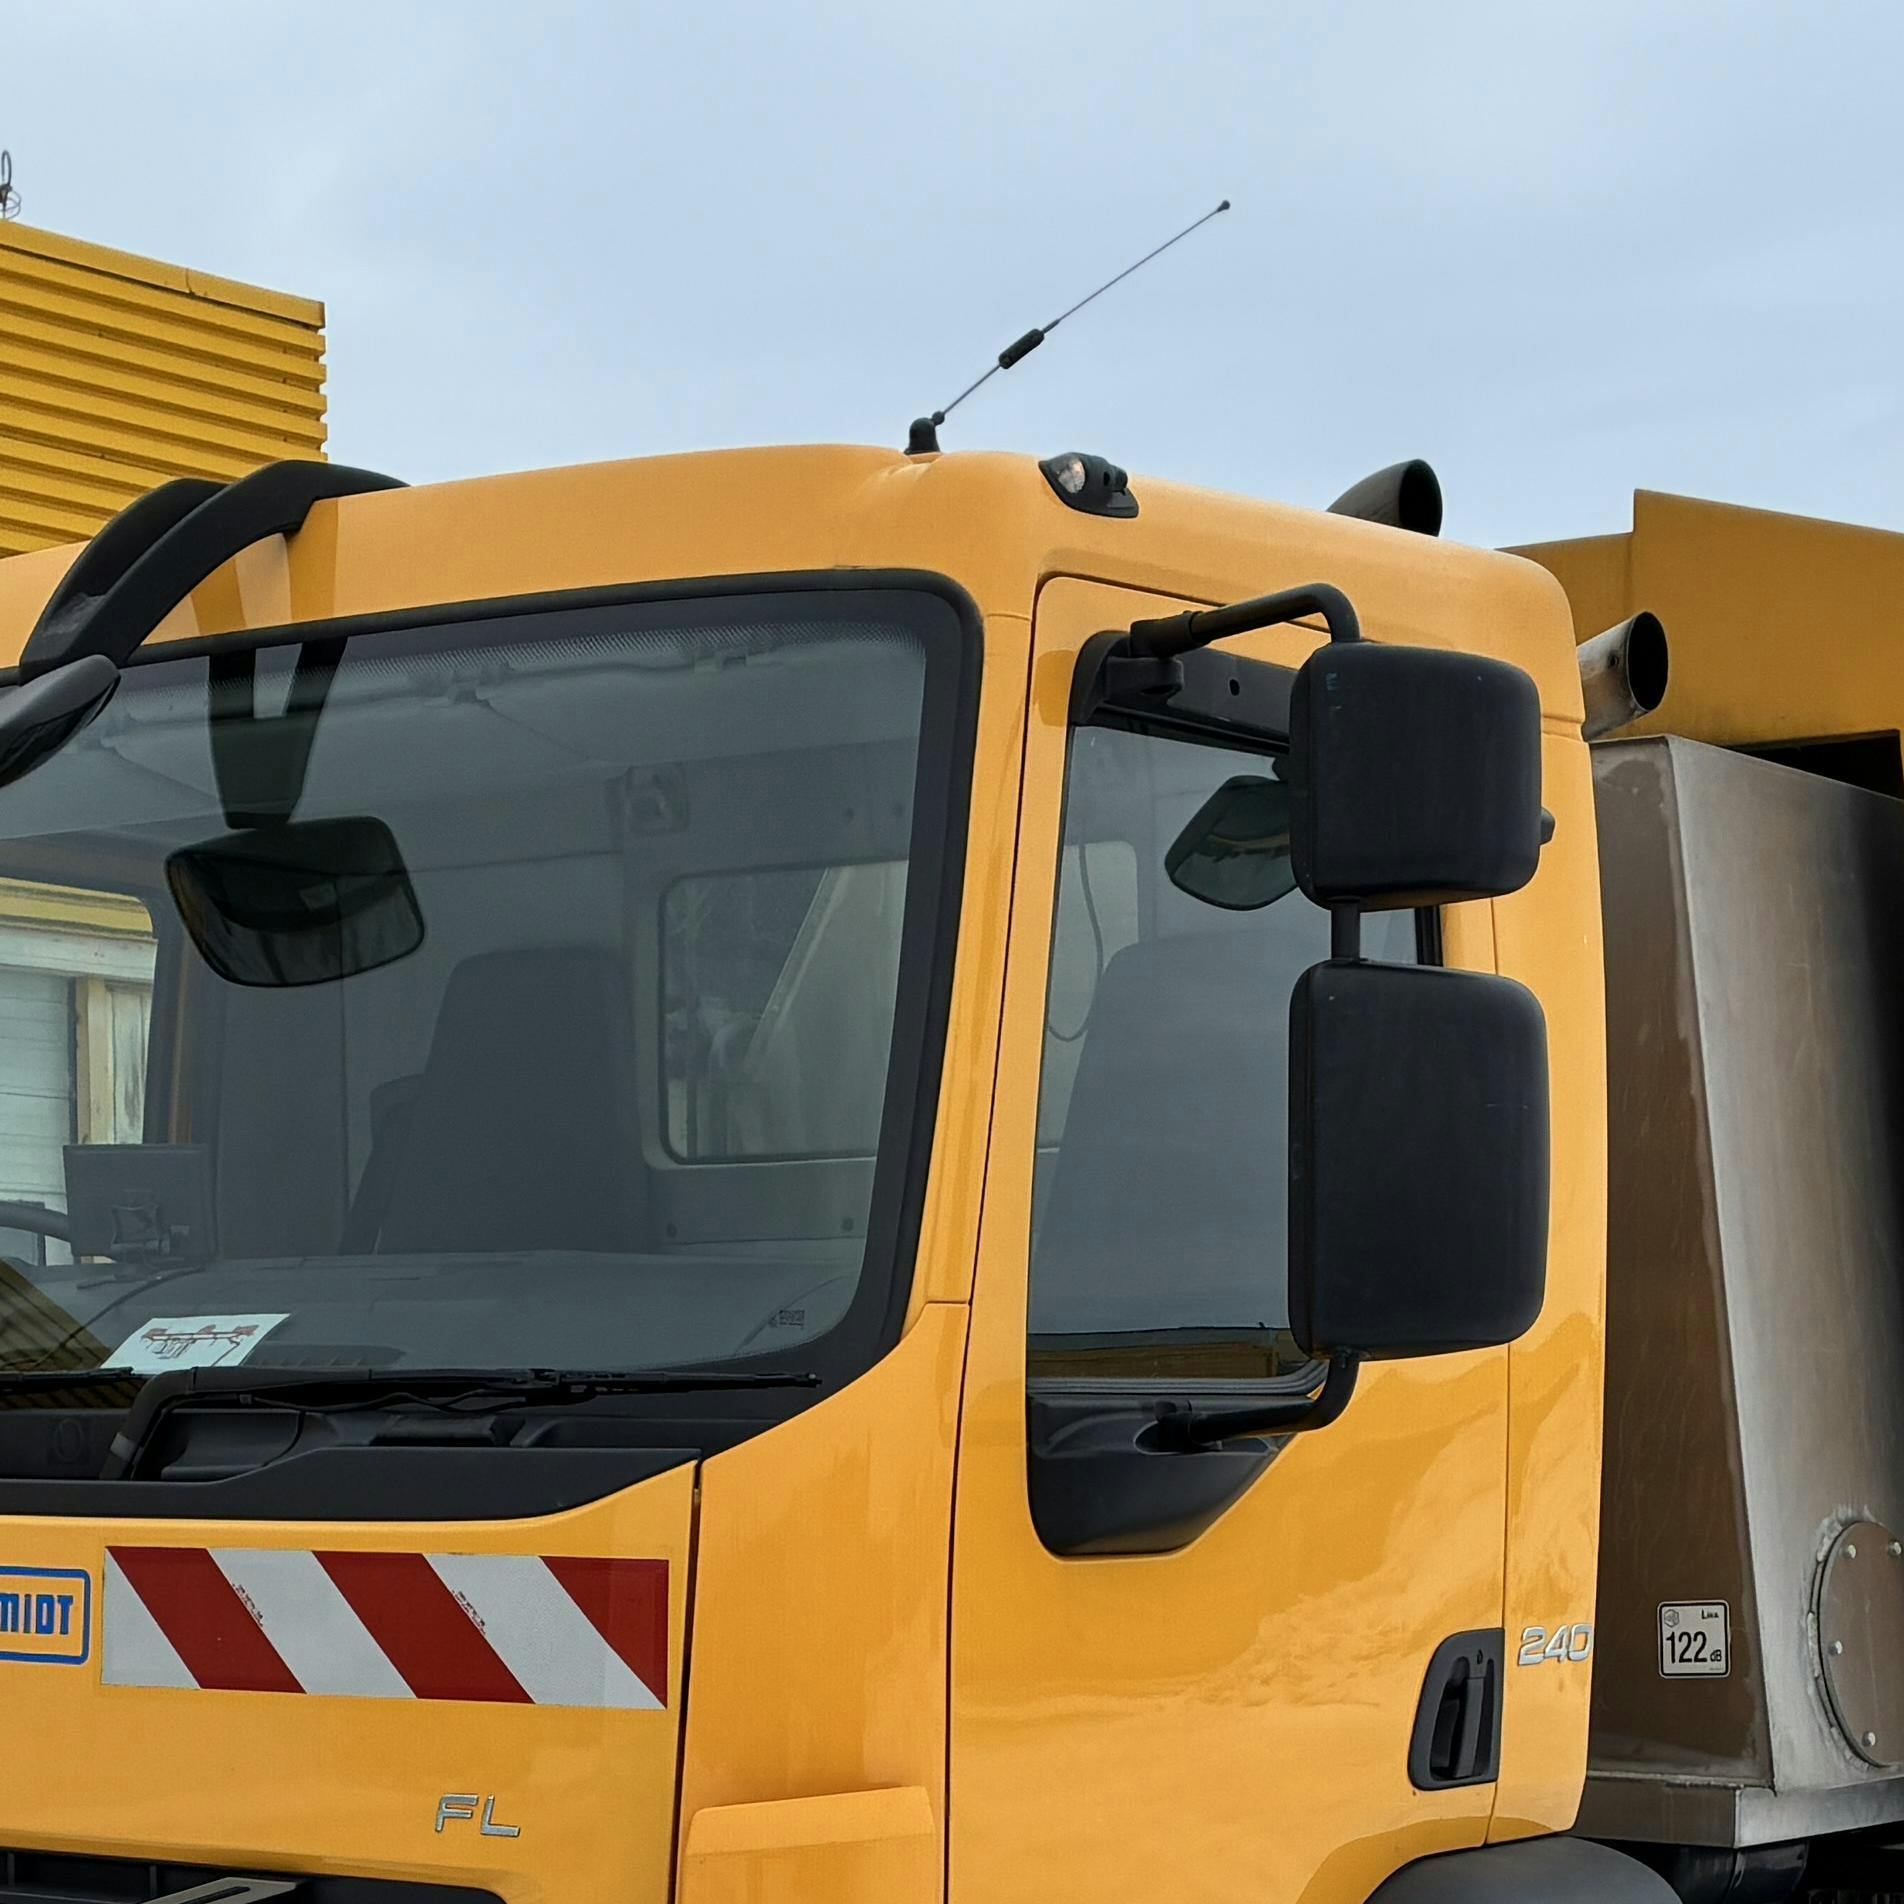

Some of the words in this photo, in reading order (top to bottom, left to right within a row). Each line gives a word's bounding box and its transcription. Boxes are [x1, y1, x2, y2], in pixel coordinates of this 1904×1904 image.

[1518, 1623, 1593, 1666] 240
[1666, 1631, 1708, 1664] 122
[434, 1792, 521, 1838] FL
